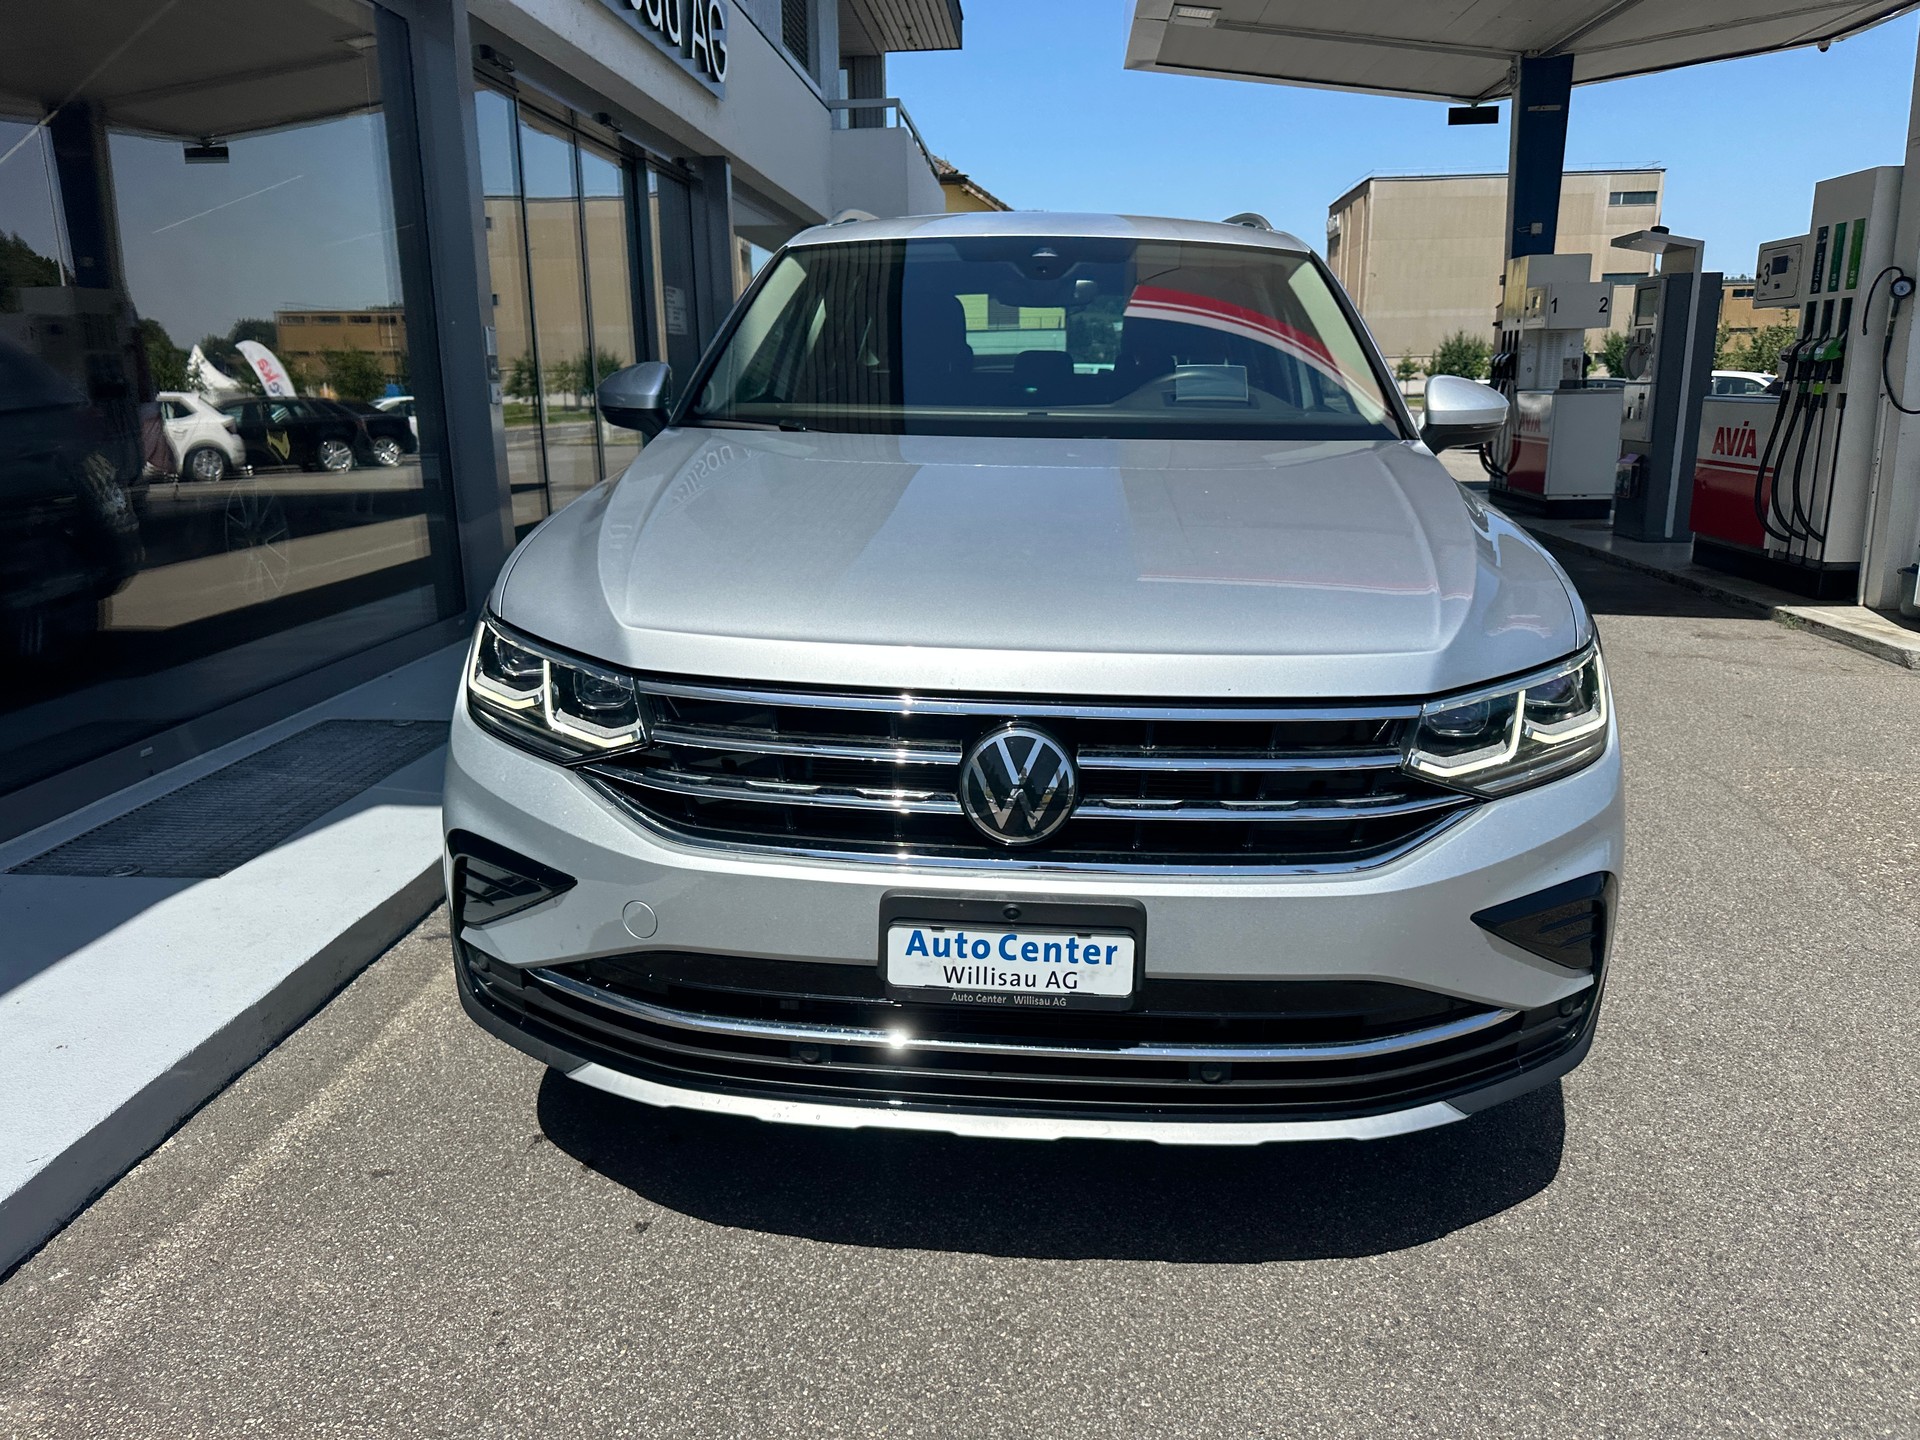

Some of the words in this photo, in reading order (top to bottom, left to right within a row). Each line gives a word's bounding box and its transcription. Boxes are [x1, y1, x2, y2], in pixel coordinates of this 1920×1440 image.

[692, 0, 728, 83] AG
[1762, 263, 1770, 286] 3
[1551, 298, 1558, 314] 1
[1598, 297, 1609, 313] 2
[905, 930, 990, 960] Auto
[998, 934, 1118, 965] Center
[943, 965, 1036, 988] Willisau
[1045, 971, 1078, 990] AG
[950, 992, 973, 1003] Auto
[976, 993, 1007, 1004] Center
[1013, 995, 1051, 1006] Willisau
[1052, 997, 1067, 1007] AG
